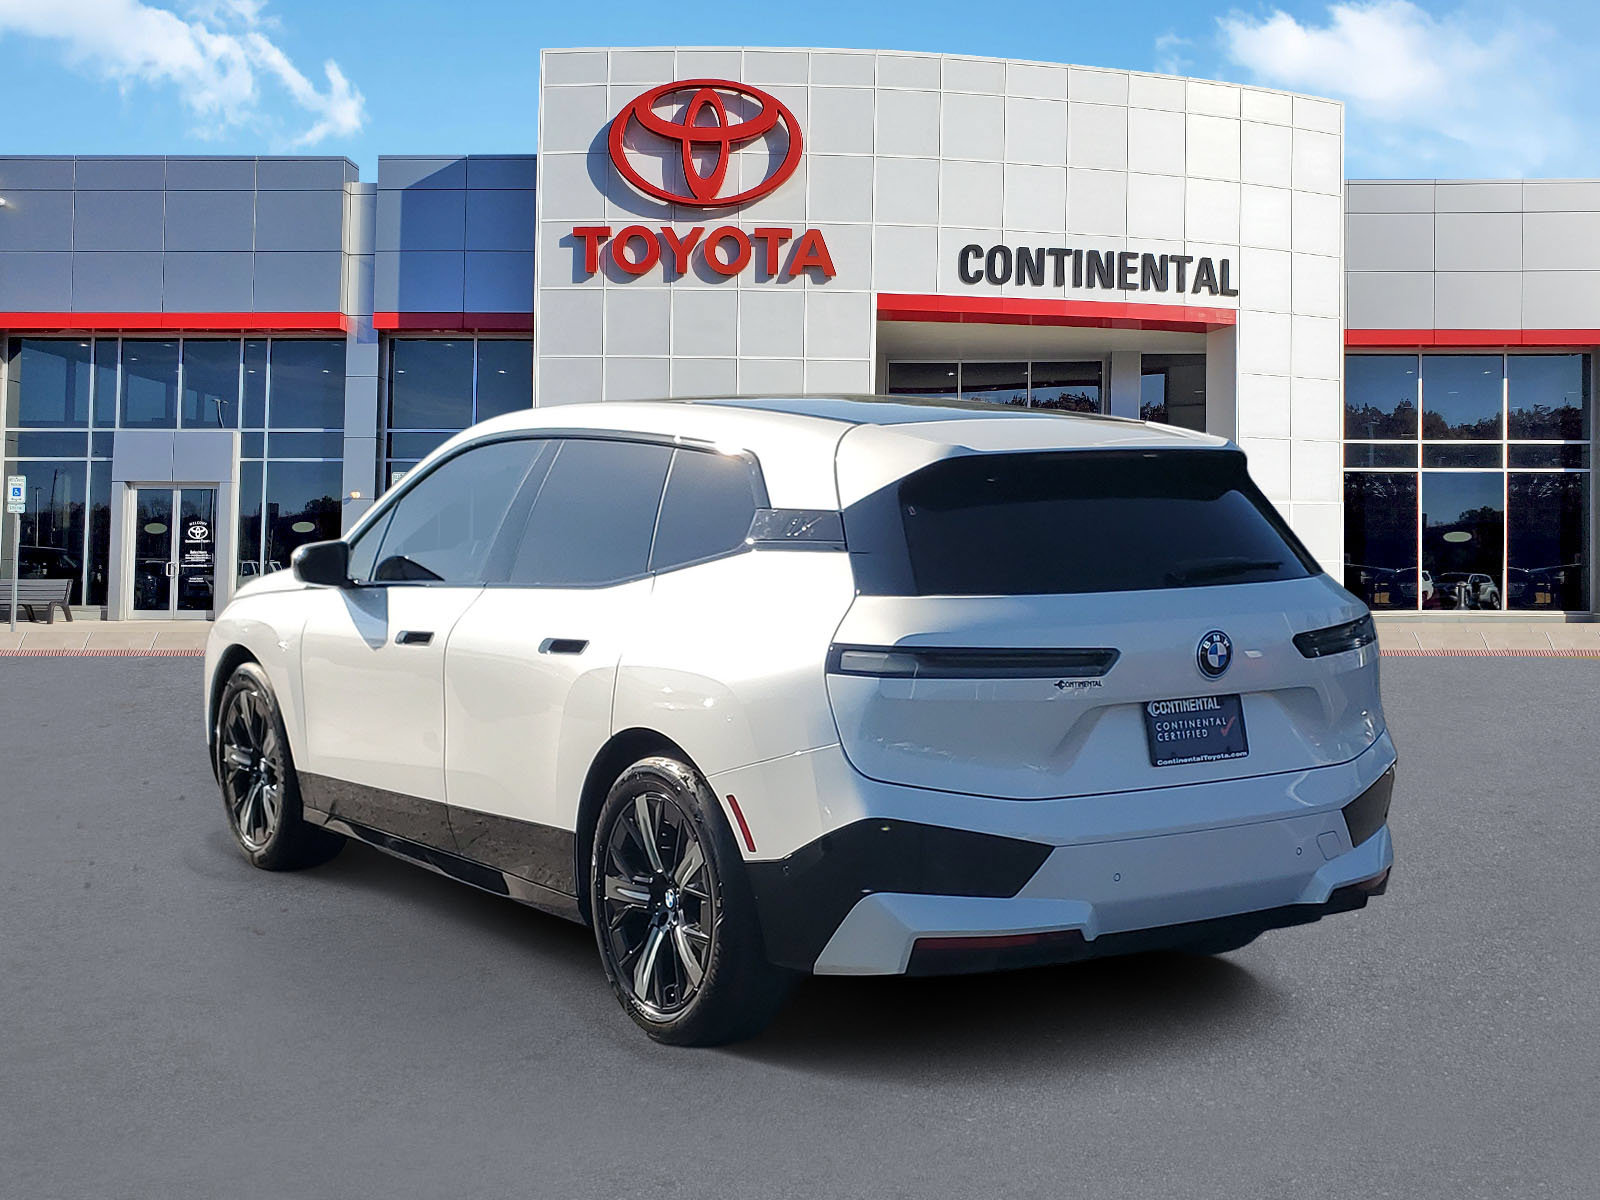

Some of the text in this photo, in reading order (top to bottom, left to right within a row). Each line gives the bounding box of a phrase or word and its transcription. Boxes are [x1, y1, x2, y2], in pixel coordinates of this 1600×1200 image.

[573, 225, 836, 276] TOYOTA
[958, 244, 1238, 296] CONTINENTAL
[1149, 697, 1221, 715] CONTINENTAL
[1156, 717, 1227, 731] CONTINENTAL
[1157, 729, 1208, 742] CERTIFIED
[1157, 751, 1248, 766] ContinentalToyota.com
